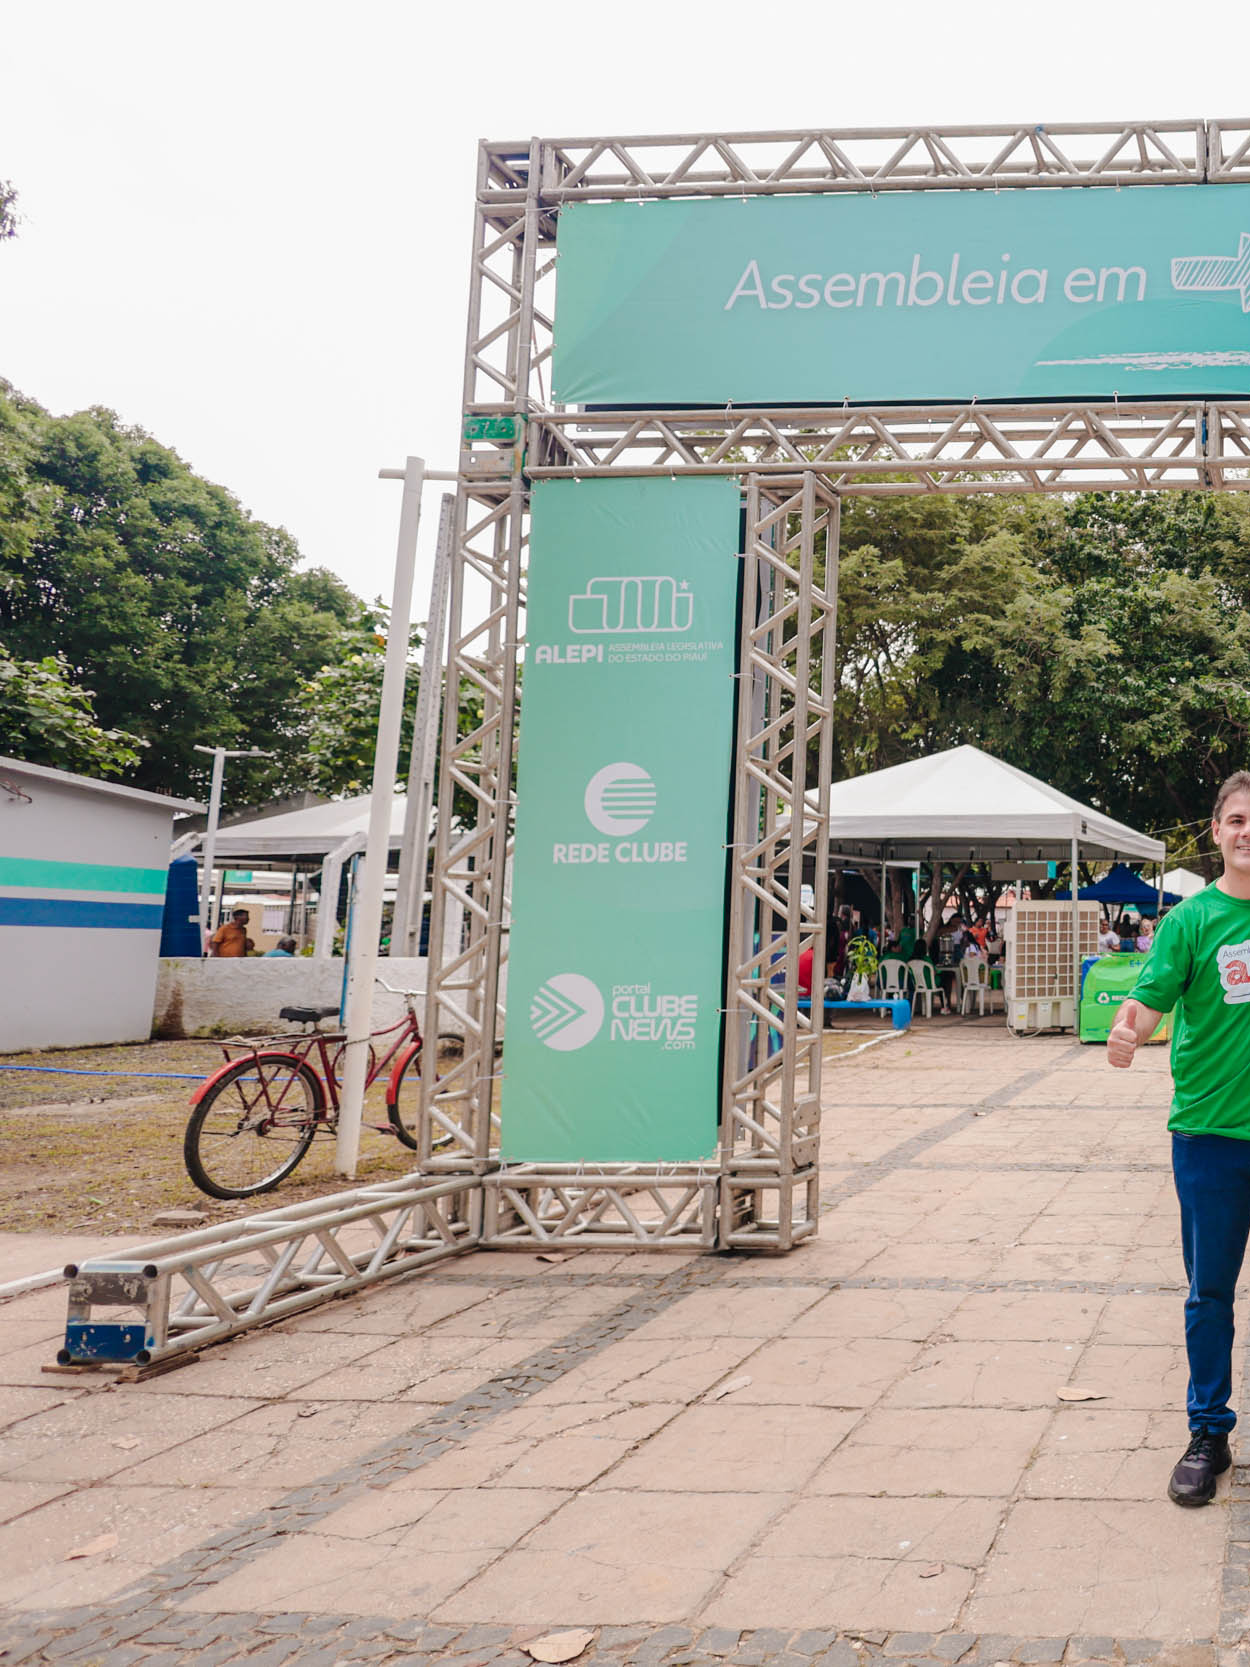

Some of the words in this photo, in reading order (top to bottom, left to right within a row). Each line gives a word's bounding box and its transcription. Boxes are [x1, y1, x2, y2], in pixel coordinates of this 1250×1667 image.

[723, 253, 1046, 311] Assembleia
[1063, 264, 1146, 301] em
[535, 644, 604, 664] ALEPI
[608, 642, 665, 652] ASSEMBLEIA
[666, 641, 724, 651] LEGISLATIVA
[608, 654, 619, 663] DO
[620, 653, 664, 663] ESTADO
[665, 652, 682, 662] DO
[683, 651, 708, 662] PIAUÍ
[552, 843, 610, 864] REDE
[615, 841, 688, 863] CLUBE
[611, 982, 651, 996] portal
[611, 995, 698, 1018] CLUBE
[610, 1018, 697, 1041] NEWS
[661, 1040, 696, 1050] .com
